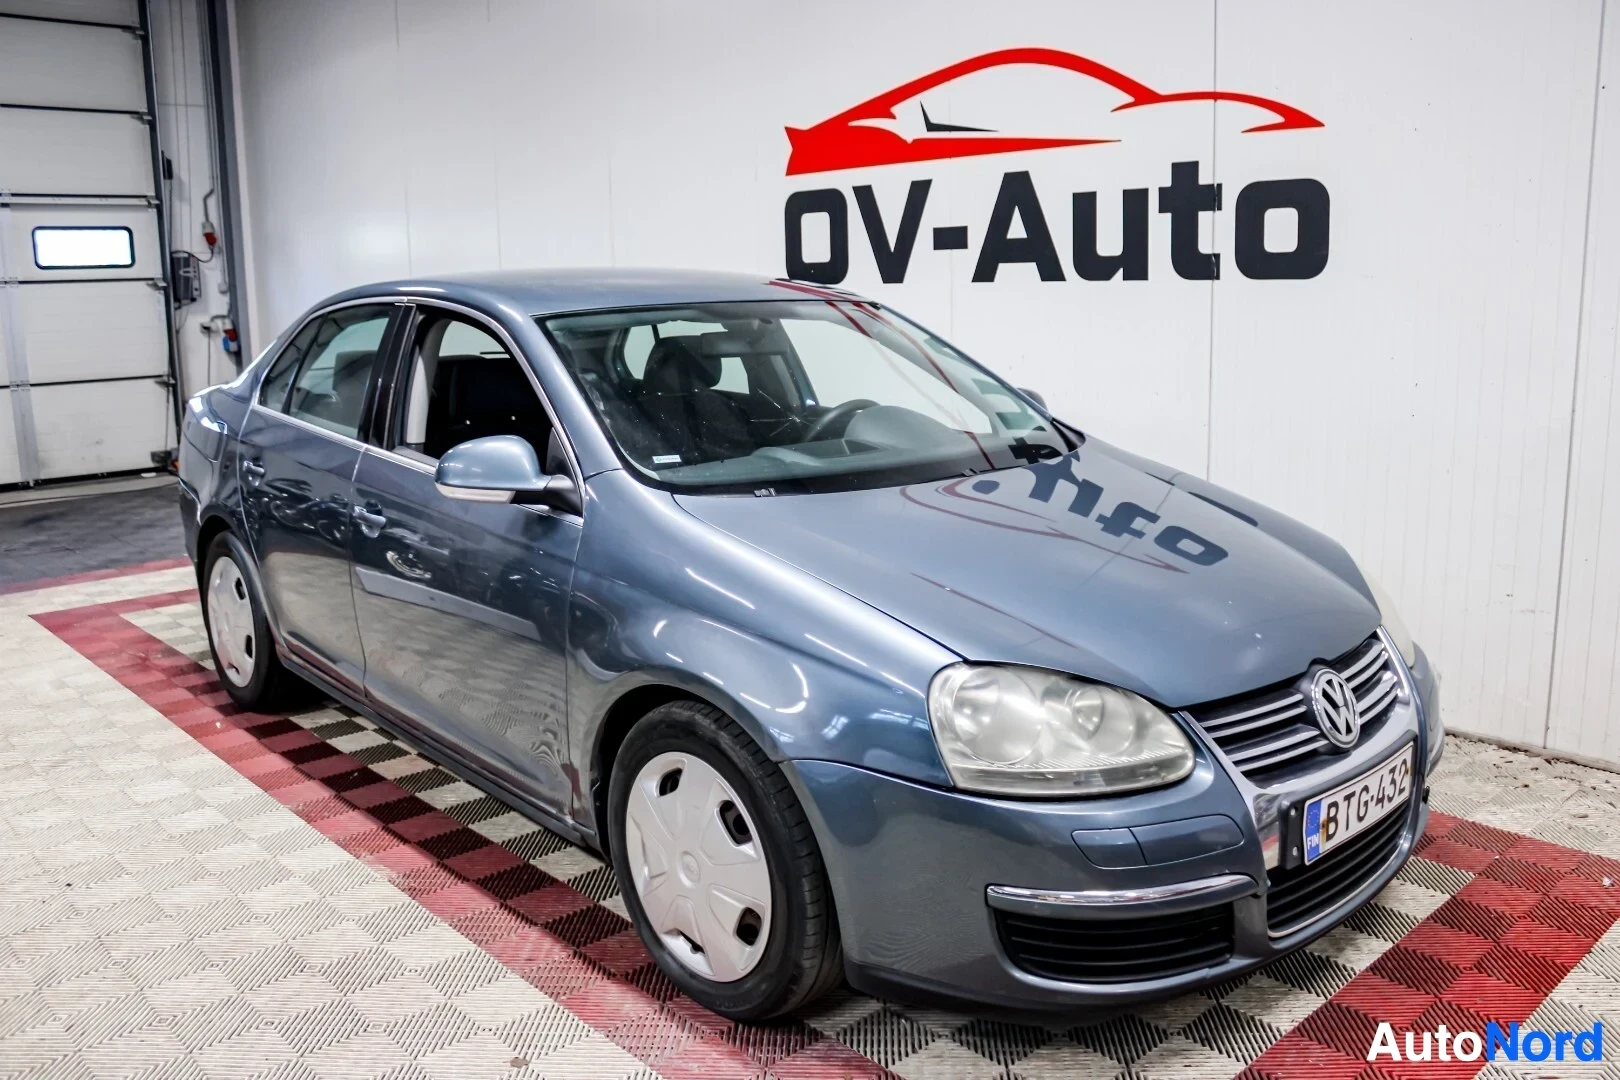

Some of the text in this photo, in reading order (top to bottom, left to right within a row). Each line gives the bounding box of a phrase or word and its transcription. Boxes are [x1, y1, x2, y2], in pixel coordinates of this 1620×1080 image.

[784, 160, 1331, 285] OV-Auto
[1316, 673, 1358, 743] VW
[1325, 758, 1409, 842] BTG-432
[1306, 832, 1320, 850] FIN
